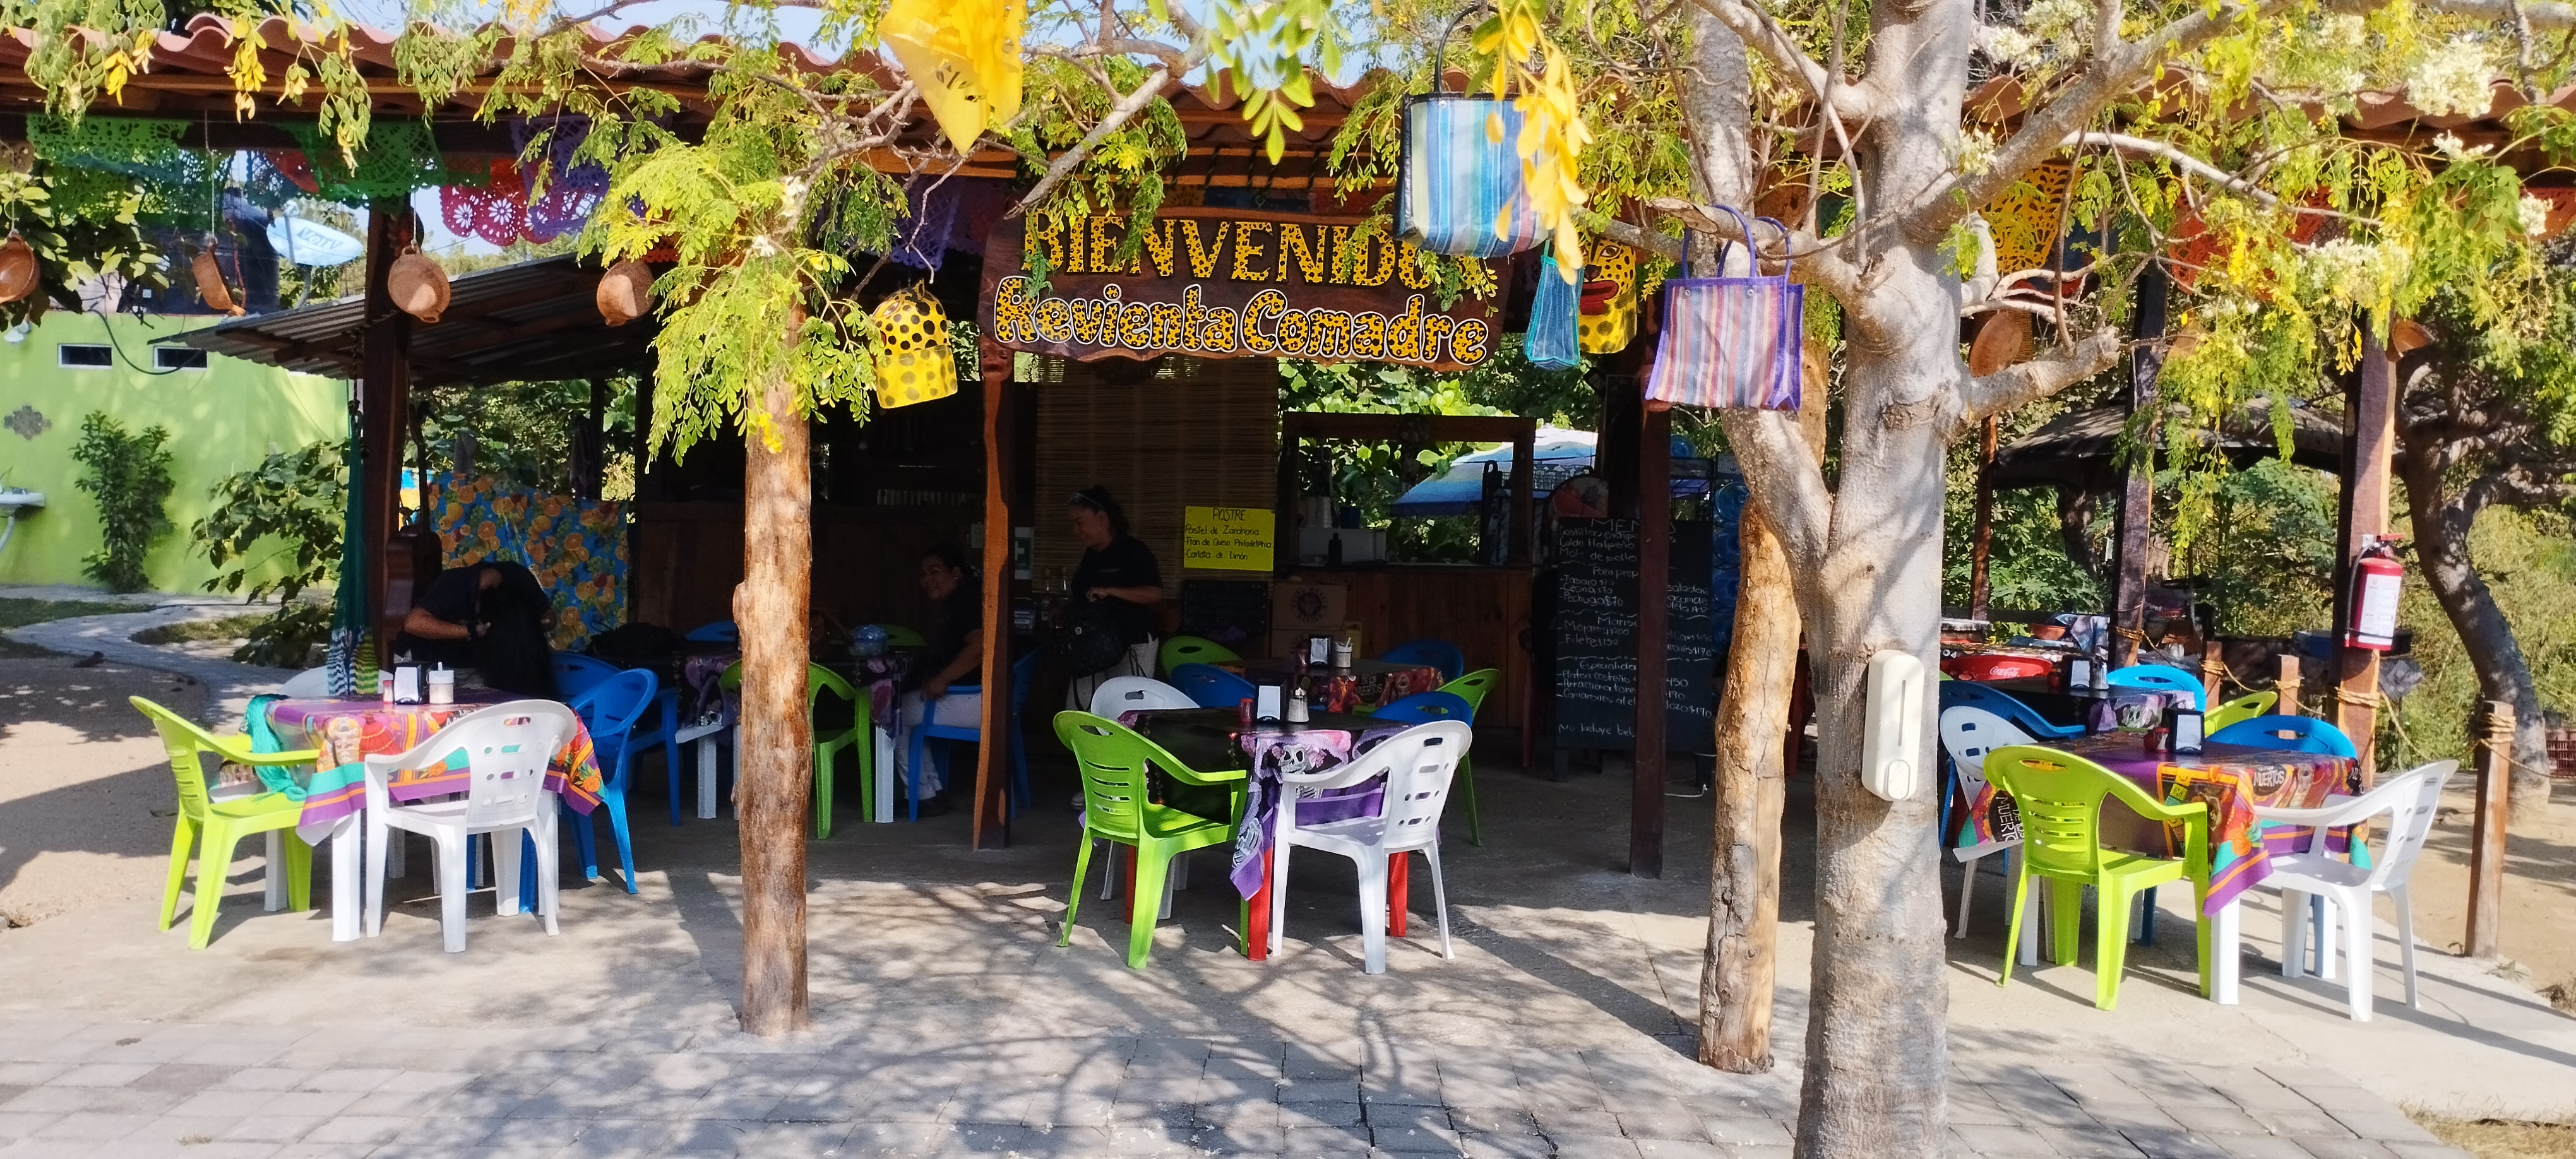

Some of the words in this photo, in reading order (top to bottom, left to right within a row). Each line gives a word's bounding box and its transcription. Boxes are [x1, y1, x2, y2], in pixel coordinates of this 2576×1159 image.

[994, 276, 1239, 354] Revienta
[1241, 288, 1489, 366] Comadre
[1212, 508, 1246, 521] POSTRE
[1185, 523, 1207, 534] Pastel
[1210, 526, 1219, 535] de
[1202, 538, 1210, 546] de
[1213, 537, 1231, 547] Queso
[1186, 549, 1211, 559] Carlota
[1590, 552, 1604, 561] de
[1606, 552, 1637, 563] pollo
[1355, 683, 1383, 696] MUERTOS
[1616, 696, 1626, 706] al
[2253, 770, 2285, 787] MUERTOS
